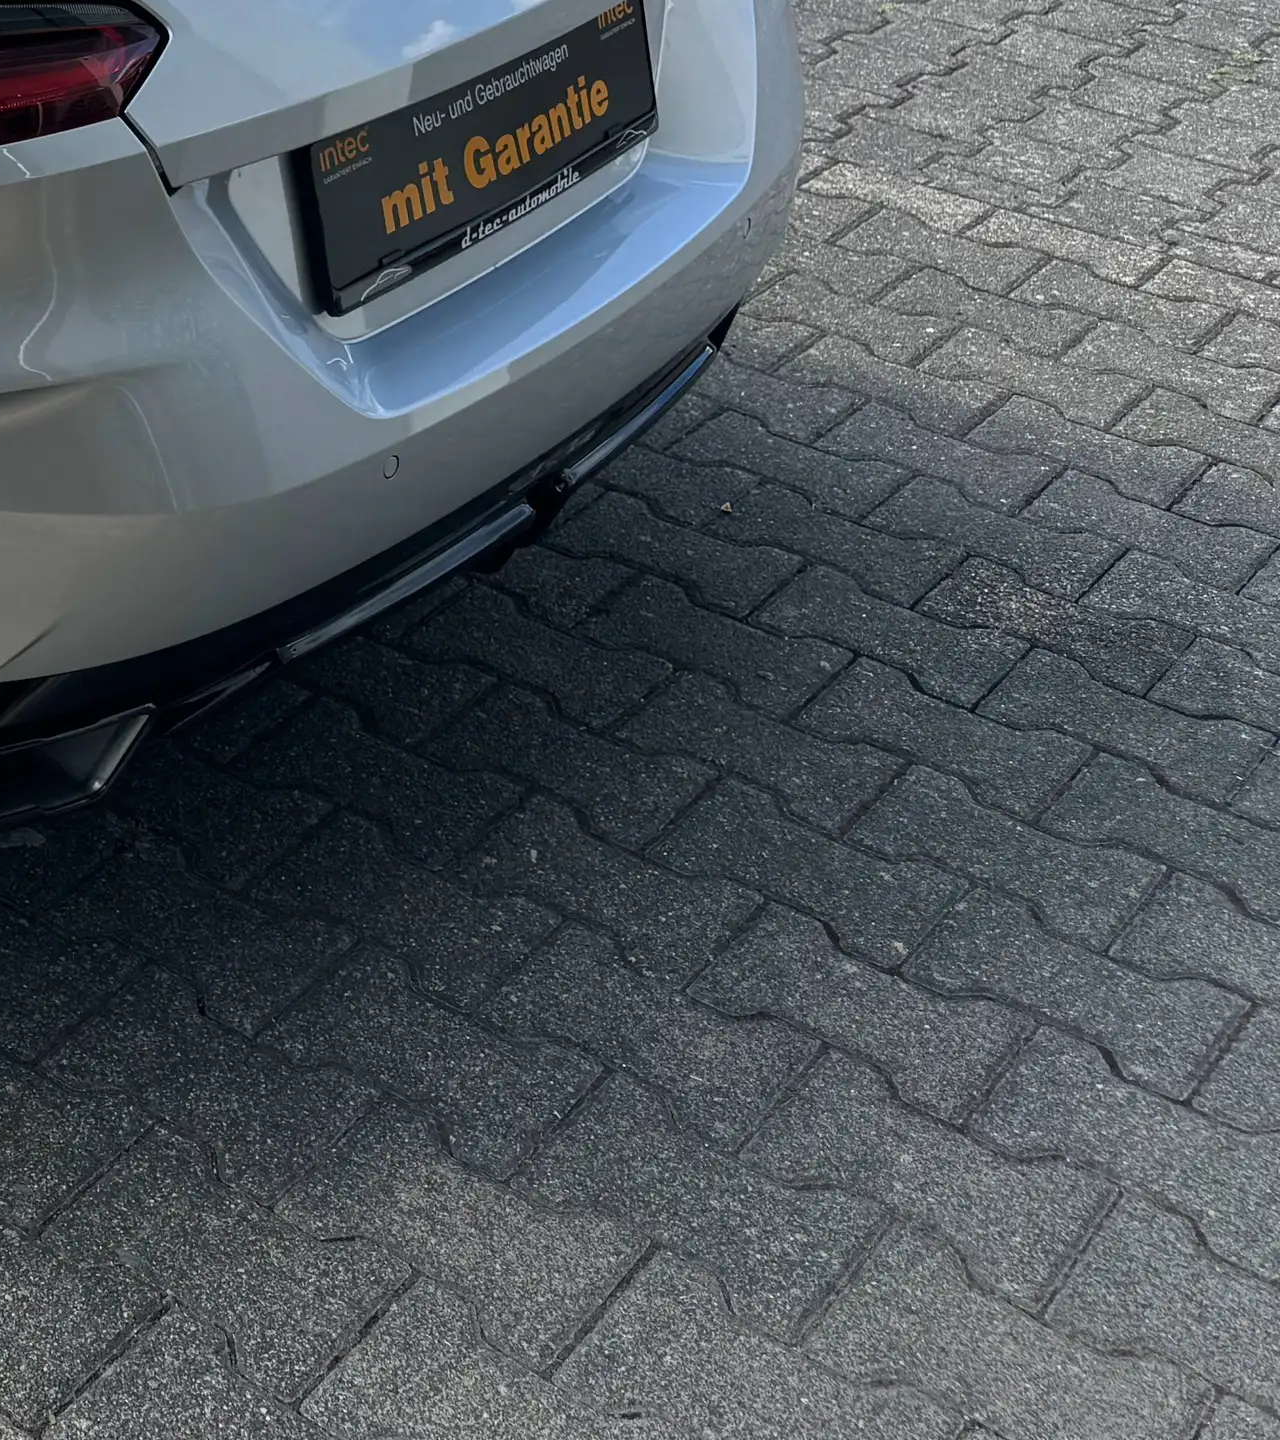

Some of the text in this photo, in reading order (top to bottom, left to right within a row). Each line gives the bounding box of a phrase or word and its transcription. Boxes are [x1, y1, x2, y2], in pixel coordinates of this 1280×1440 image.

[412, 44, 569, 137] Neu- und Gebrauchtwagen
[319, 130, 370, 172] intec
[381, 75, 609, 235] mit Garantie
[461, 167, 581, 249] d-tec-automobile
